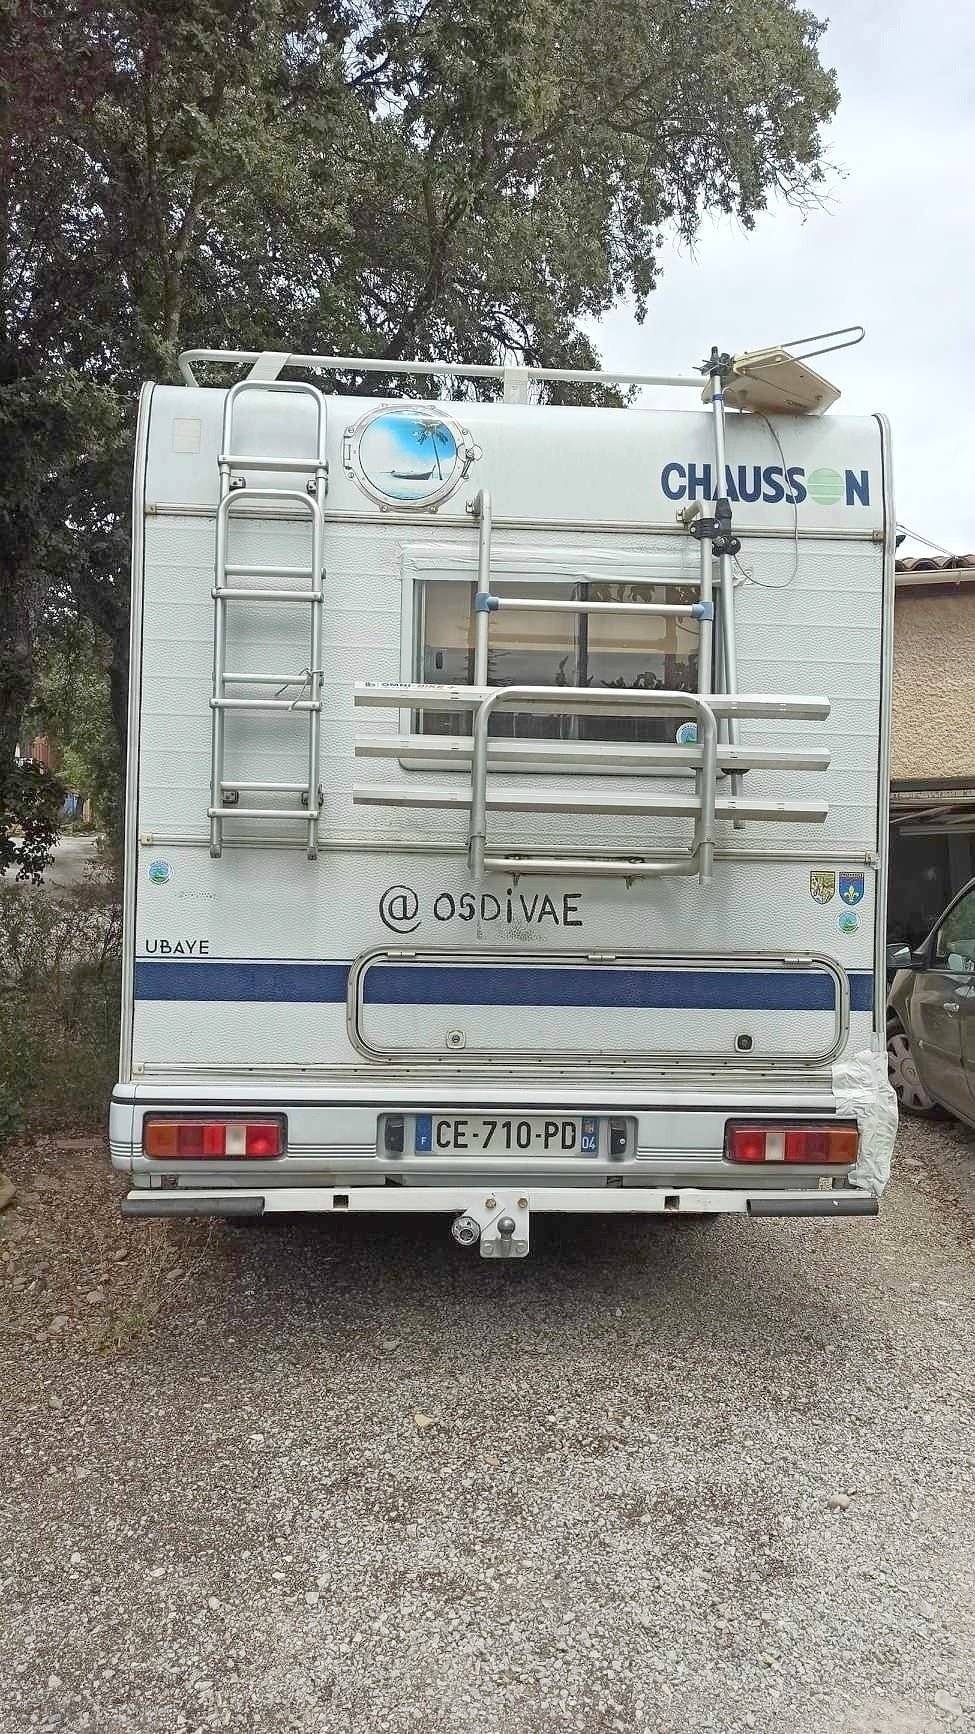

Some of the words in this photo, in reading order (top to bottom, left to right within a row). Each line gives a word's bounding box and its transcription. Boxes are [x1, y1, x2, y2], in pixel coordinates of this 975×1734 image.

[379, 885, 421, 934] @
[145, 939, 209, 954] UBAYE
[421, 1136, 427, 1145] F
[436, 1120, 576, 1149] CE-710-PD
[582, 1136, 596, 1149] 04
